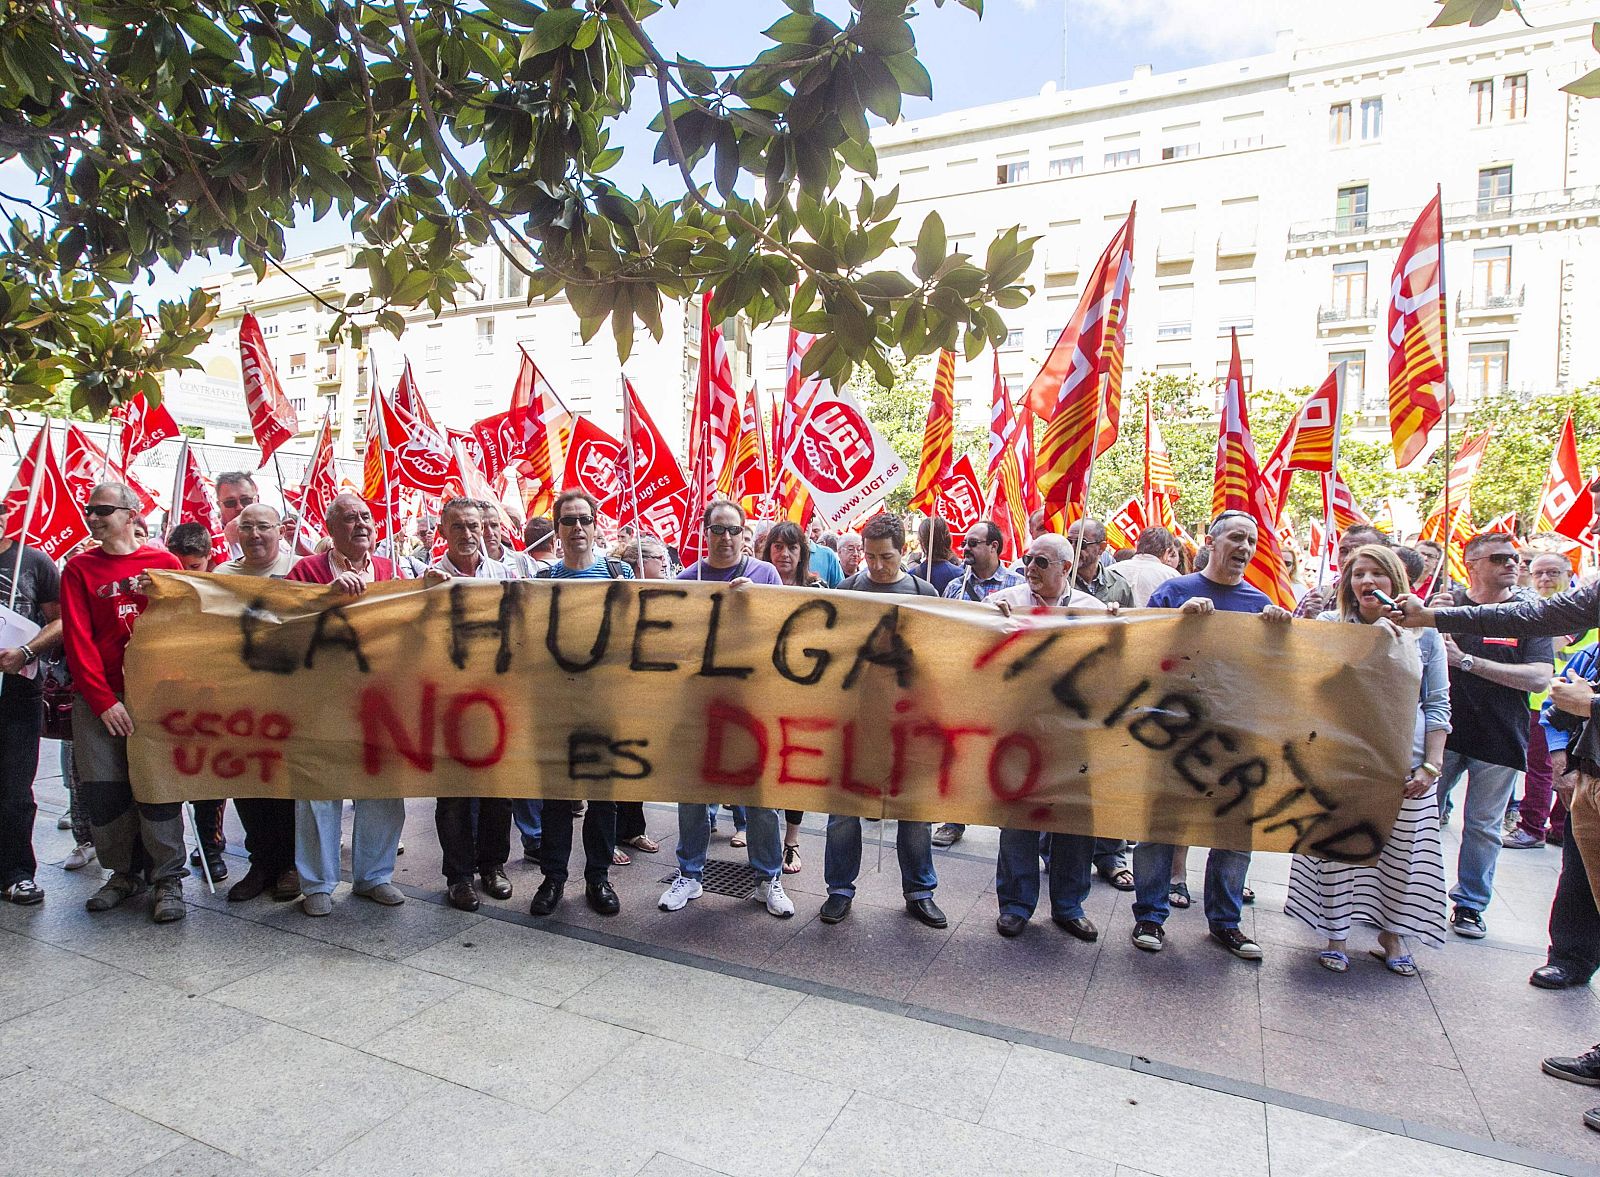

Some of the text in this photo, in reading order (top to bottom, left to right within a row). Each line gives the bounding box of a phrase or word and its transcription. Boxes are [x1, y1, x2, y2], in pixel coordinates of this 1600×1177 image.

[813, 405, 872, 471] UGT
[831, 462, 900, 523] www.UGT.es
[944, 479, 979, 522] UGT
[241, 580, 914, 690] LA HUELGA
[160, 707, 294, 741] CCOO
[355, 680, 507, 778] NO
[567, 729, 654, 781] ES
[171, 745, 283, 784] UGT
